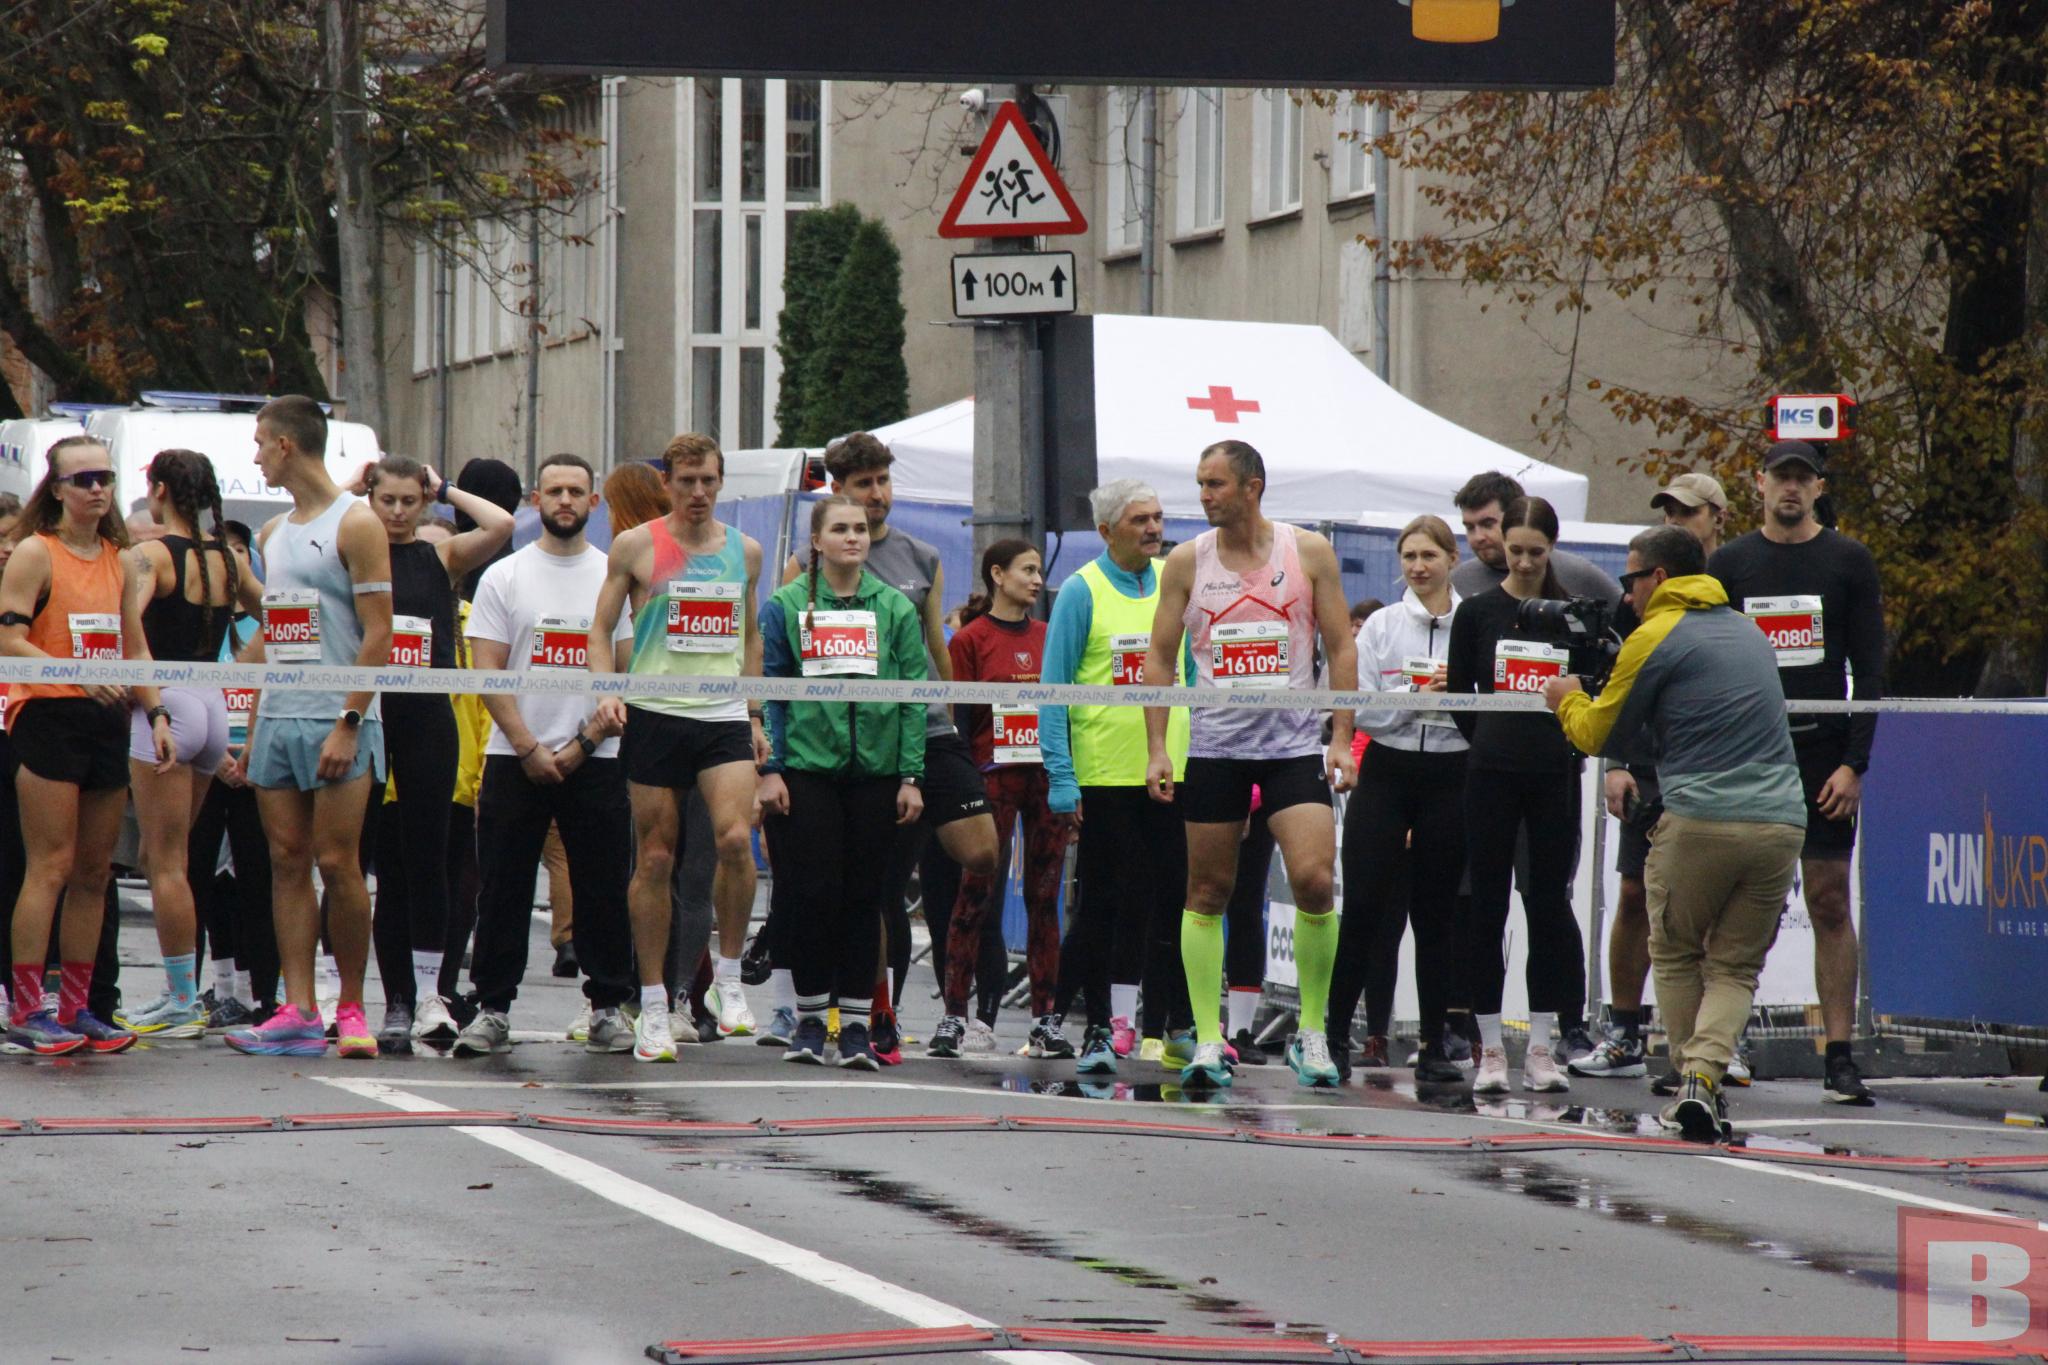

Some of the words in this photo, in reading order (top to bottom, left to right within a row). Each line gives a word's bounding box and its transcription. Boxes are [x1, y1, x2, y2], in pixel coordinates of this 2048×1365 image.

[1780, 408, 1815, 424] IKS
[270, 623, 310, 641] 16095
[681, 615, 730, 633] 16001
[1768, 628, 1812, 648] 6080
[389, 647, 420, 665] 101
[544, 646, 587, 665] 1610
[814, 639, 867, 656] 16006
[1224, 655, 1278, 674] 16109
[41, 666, 73, 678] RUN
[75, 665, 144, 680] UKRAINE
[153, 669, 186, 681] RUN
[187, 668, 257, 683] UKRAINE
[264, 672, 298, 684] RUN
[299, 671, 367, 686] UKRAINE
[374, 675, 407, 687] RUN
[409, 674, 475, 689] UKRAINE
[483, 678, 516, 689] RUN
[517, 677, 583, 691] UKRAINE
[591, 680, 624, 691] RUN
[626, 680, 690, 693] UKRAINE
[698, 682, 731, 693] RUN
[732, 682, 797, 695] UKRAINE
[805, 685, 838, 696] RUN
[840, 684, 904, 697] UKRAINE
[911, 687, 944, 698] RUN
[1017, 689, 1049, 700] RUN
[1123, 691, 1155, 702] RUN
[1507, 673, 1549, 693] 1602
[227, 693, 253, 710] 005
[1005, 727, 1040, 745] 1609
[1927, 832, 1984, 906] RUN
[1998, 920, 2012, 935] WE
[2018, 921, 2037, 937] ARE
